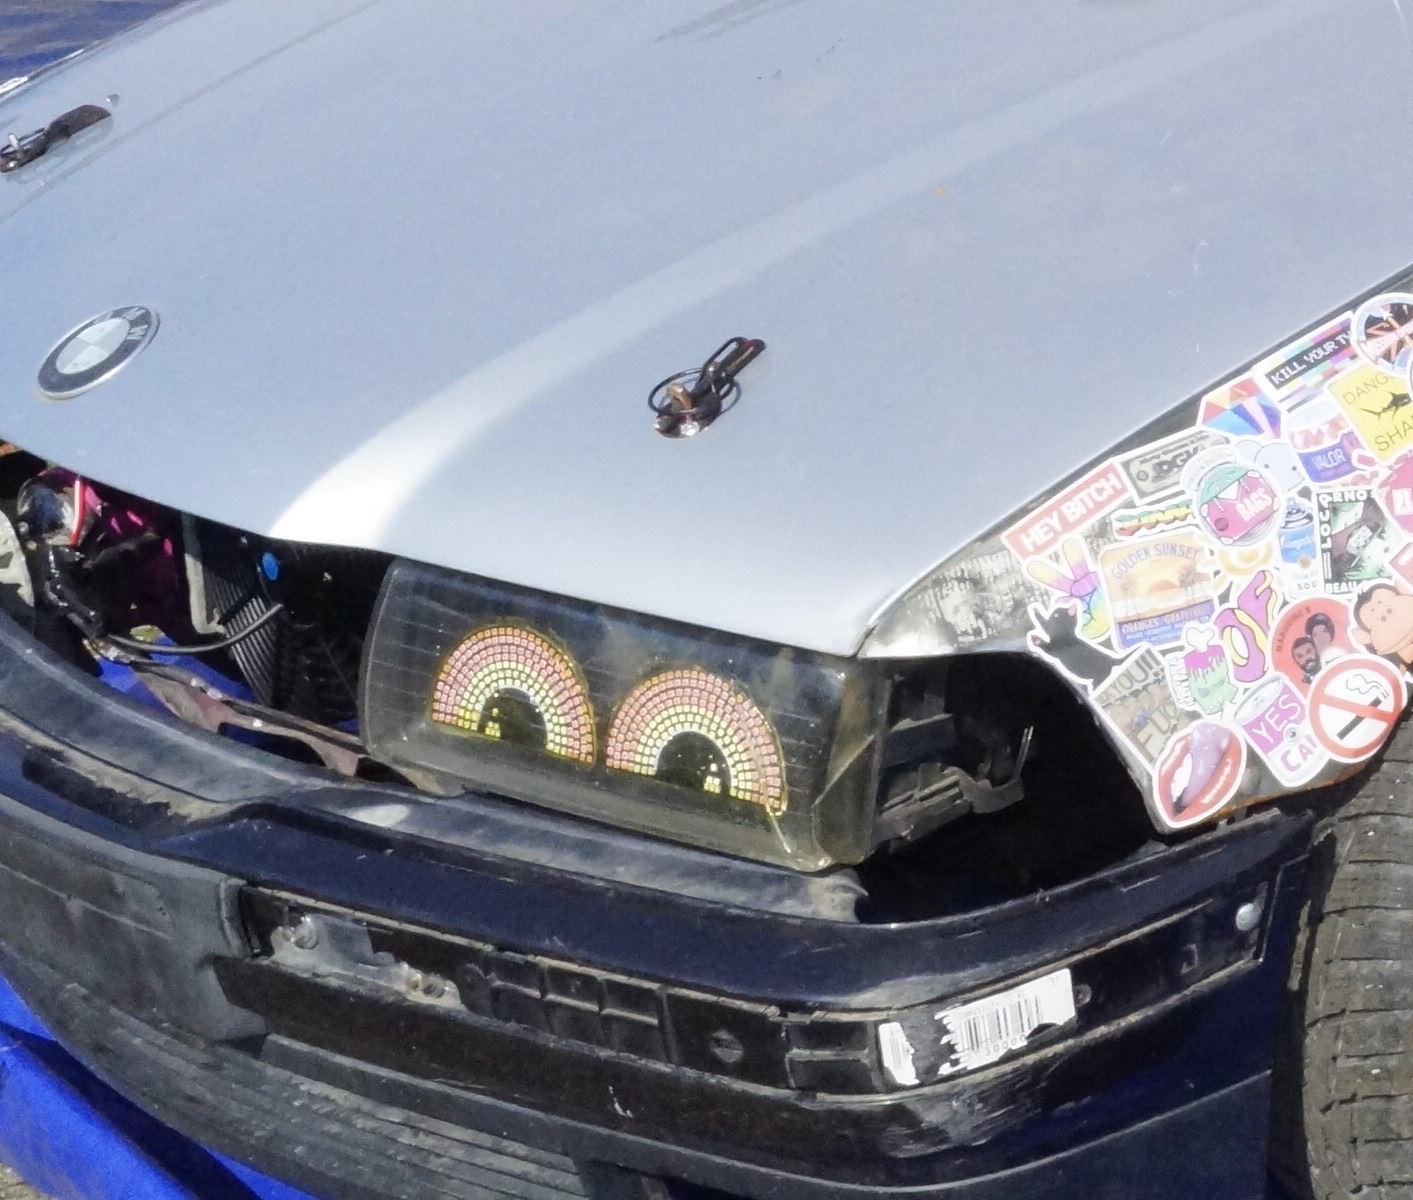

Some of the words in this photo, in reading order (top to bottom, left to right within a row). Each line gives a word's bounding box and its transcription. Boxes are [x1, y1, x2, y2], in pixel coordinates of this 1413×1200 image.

[1270, 360, 1306, 386] KILL
[1303, 340, 1339, 364] YOUR
[1311, 449, 1347, 471] VALOR
[1019, 510, 1064, 553] HEY
[1060, 472, 1124, 523] BITCH
[1235, 487, 1272, 522] BAGS
[1111, 547, 1152, 581] GOLDEN
[1154, 542, 1201, 561] SUNSET
[1251, 693, 1302, 744] YES
